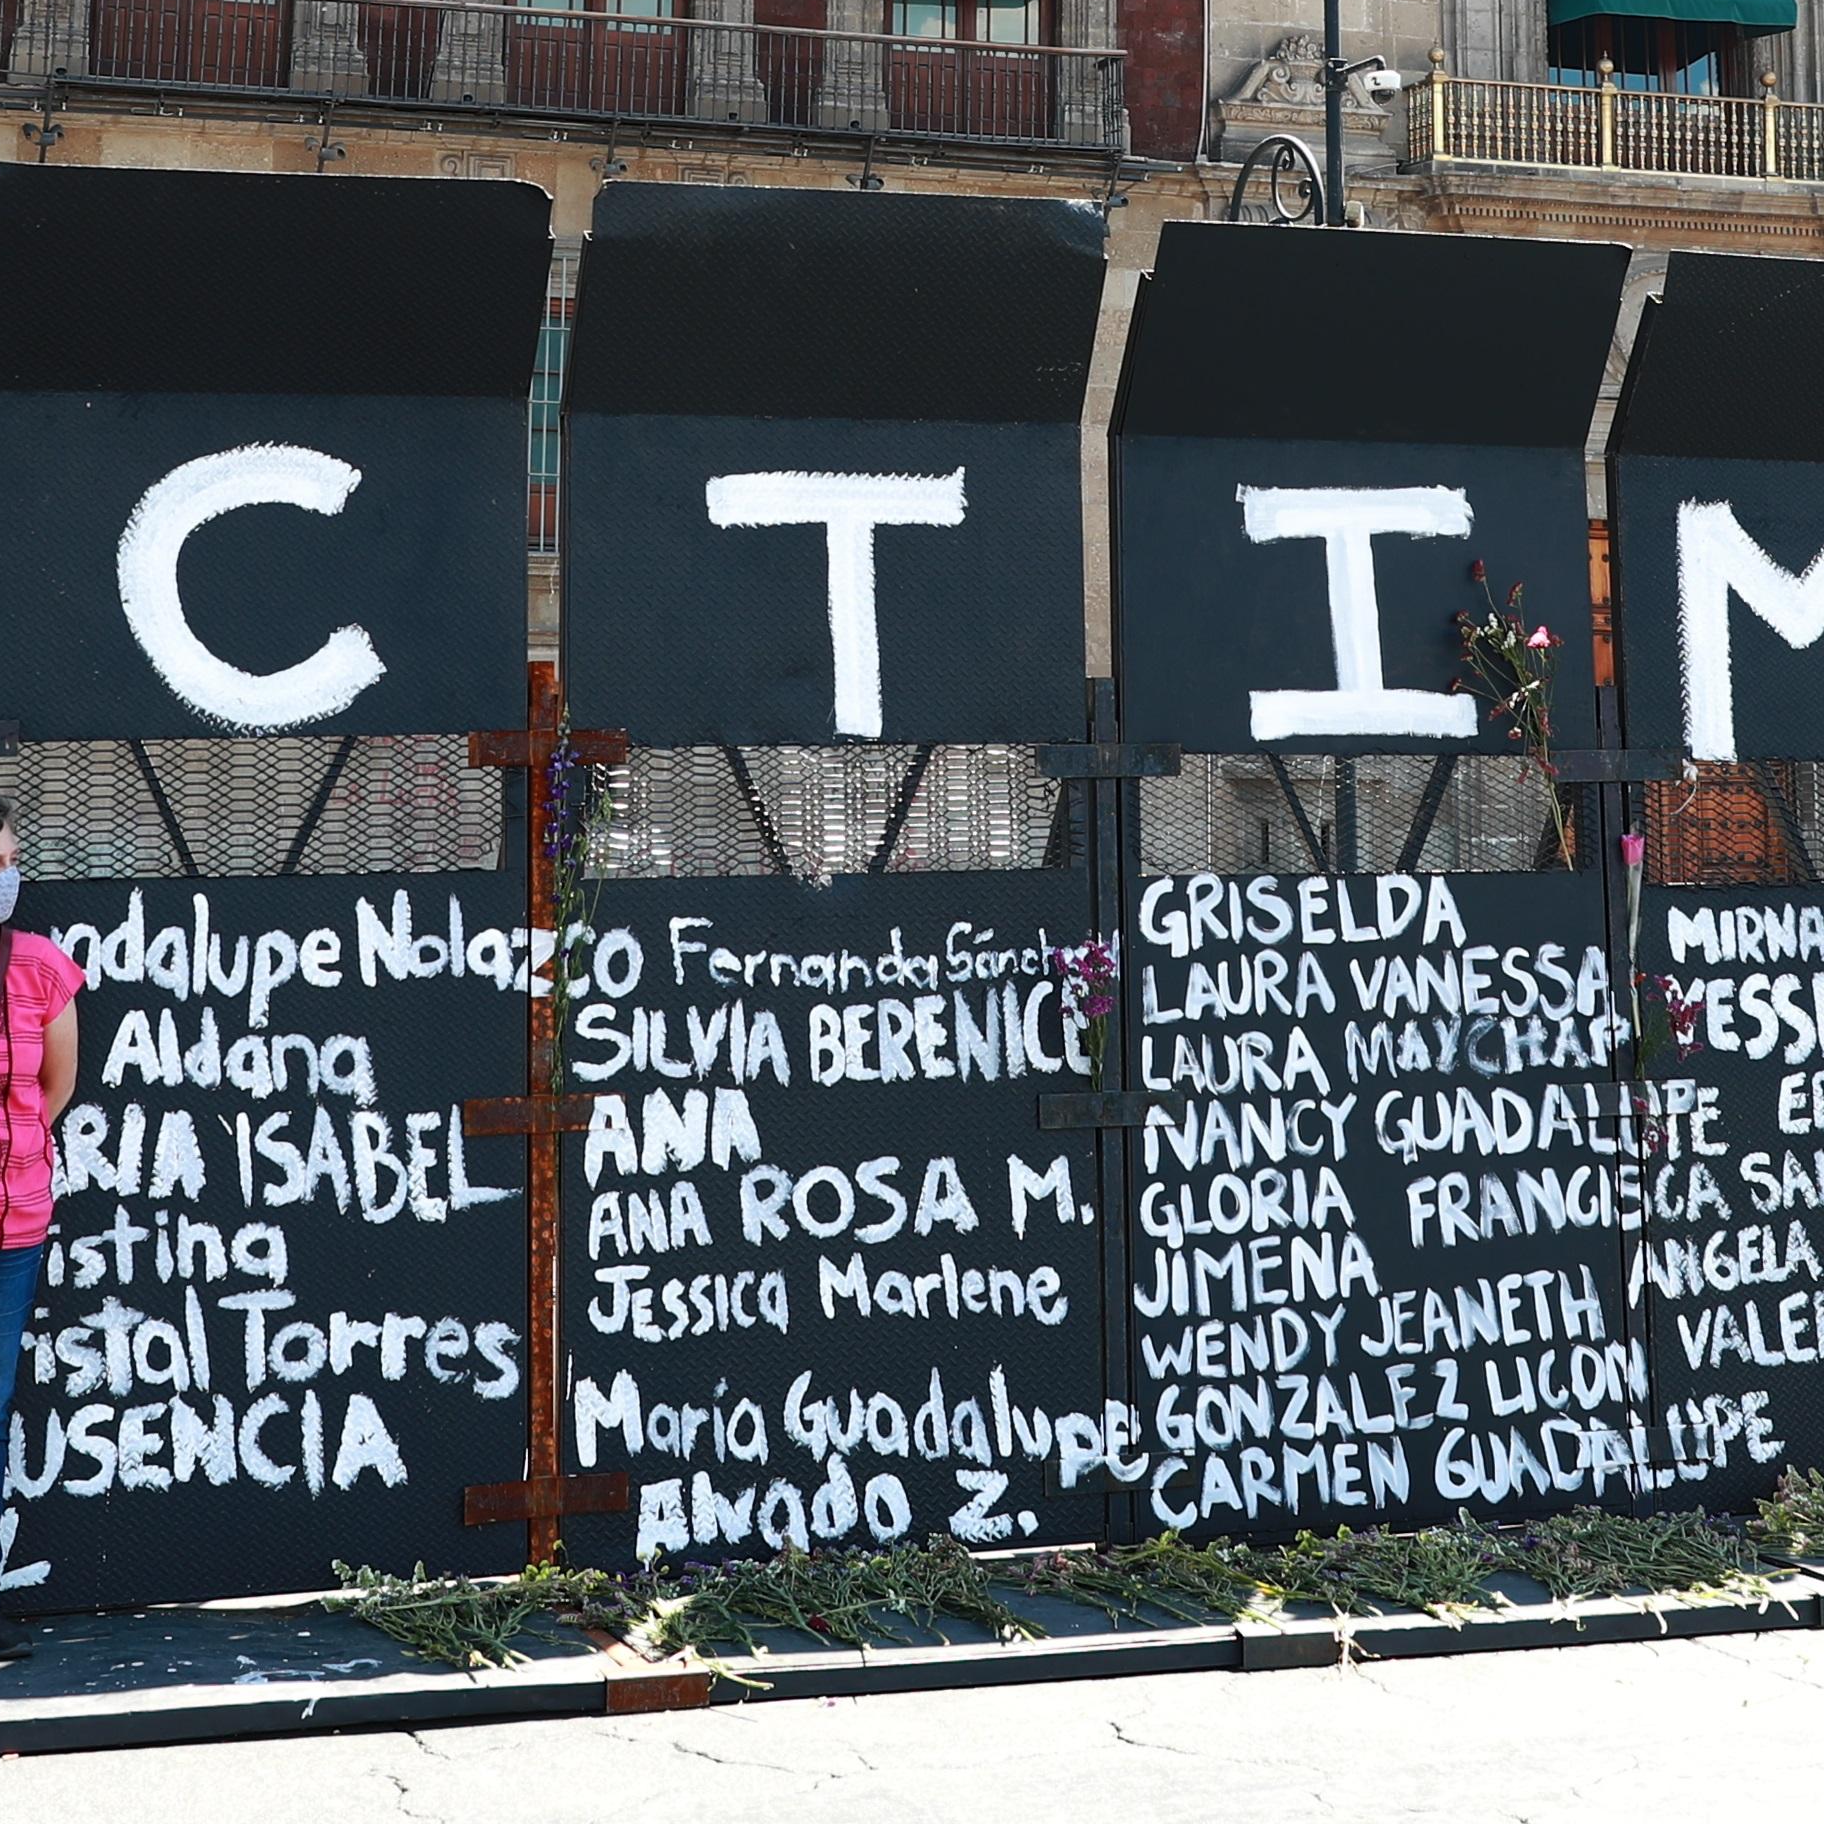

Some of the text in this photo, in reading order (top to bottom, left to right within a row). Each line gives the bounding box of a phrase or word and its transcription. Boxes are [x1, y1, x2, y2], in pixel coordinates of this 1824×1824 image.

[50, 886, 342, 1028] adalupe
[669, 916, 937, 997] Fernanda
[1138, 872, 1467, 957] GRISELDA
[1141, 942, 1616, 1024] LAURA VANESSA
[102, 1006, 377, 1108] Aldana
[572, 998, 790, 1085] SILVIA
[1141, 1025, 1330, 1095] LAURA
[232, 1102, 523, 1224] ISABEL
[583, 1086, 761, 1190] ANA
[1144, 1092, 1357, 1174] NANCY
[1374, 1079, 1731, 1165] GUADALUPE
[41, 1205, 288, 1288] istina
[588, 1154, 1096, 1260] ANA ROSA M.
[1139, 1166, 1355, 1249] GLORIA
[1405, 1160, 1733, 1249] FRANCISCA
[818, 1252, 1069, 1326] Marlene
[1133, 1230, 1382, 1318] JIMENA
[1627, 1219, 1823, 1310] ANGELA
[20, 1284, 522, 1401] istal Torres
[1141, 1304, 1346, 1379] WENDY
[1361, 1265, 1606, 1358] JEANETH
[2, 1388, 408, 1501] USENCIA
[783, 1366, 1149, 1488] Guadalupe
[1155, 1359, 1469, 1452] GONZALEZ
[949, 1469, 1039, 1543] Z.
[1151, 1390, 1784, 1530] CARMEN GUADALUPE
